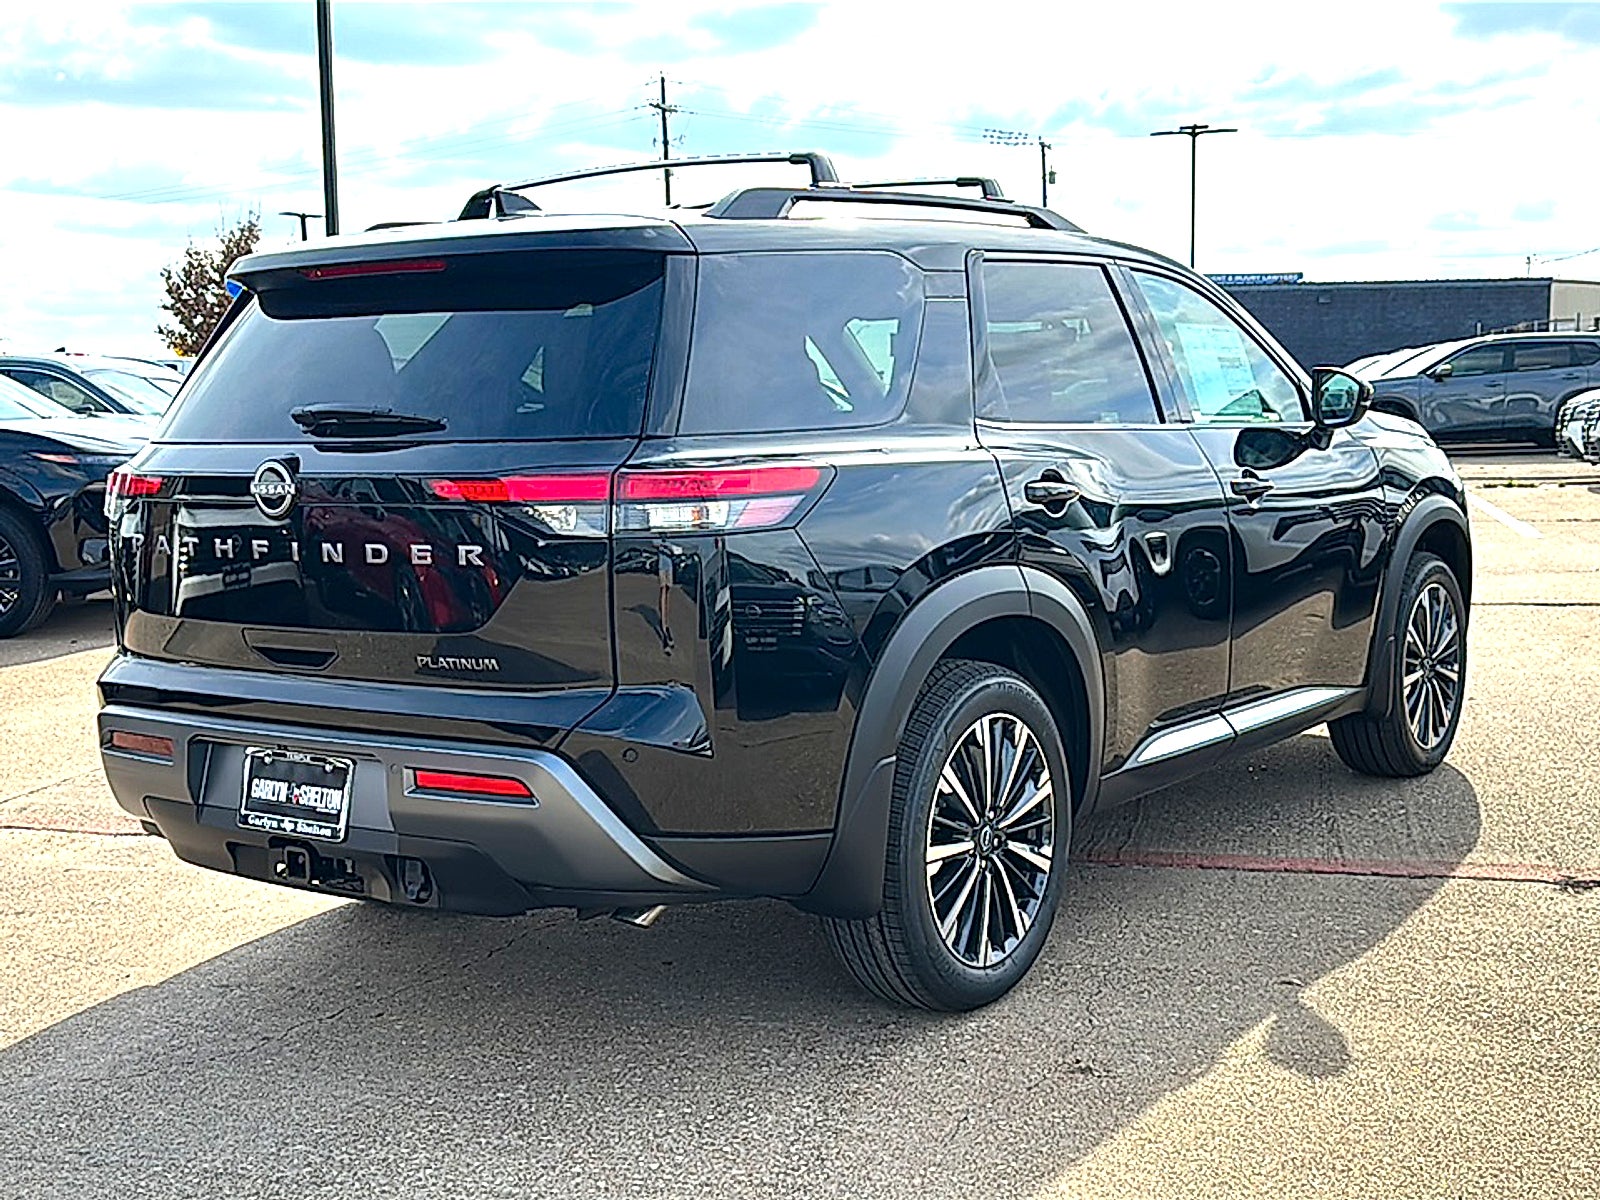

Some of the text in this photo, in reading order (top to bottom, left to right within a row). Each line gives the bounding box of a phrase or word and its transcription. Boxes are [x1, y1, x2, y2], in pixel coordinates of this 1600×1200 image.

[250, 484, 296, 494] NISSAN
[131, 533, 485, 568] PATHFINDER
[415, 654, 499, 672] PLATINUM
[251, 778, 342, 810] GARLYN SHELTON
[247, 815, 331, 837] Garlyn Shelton
